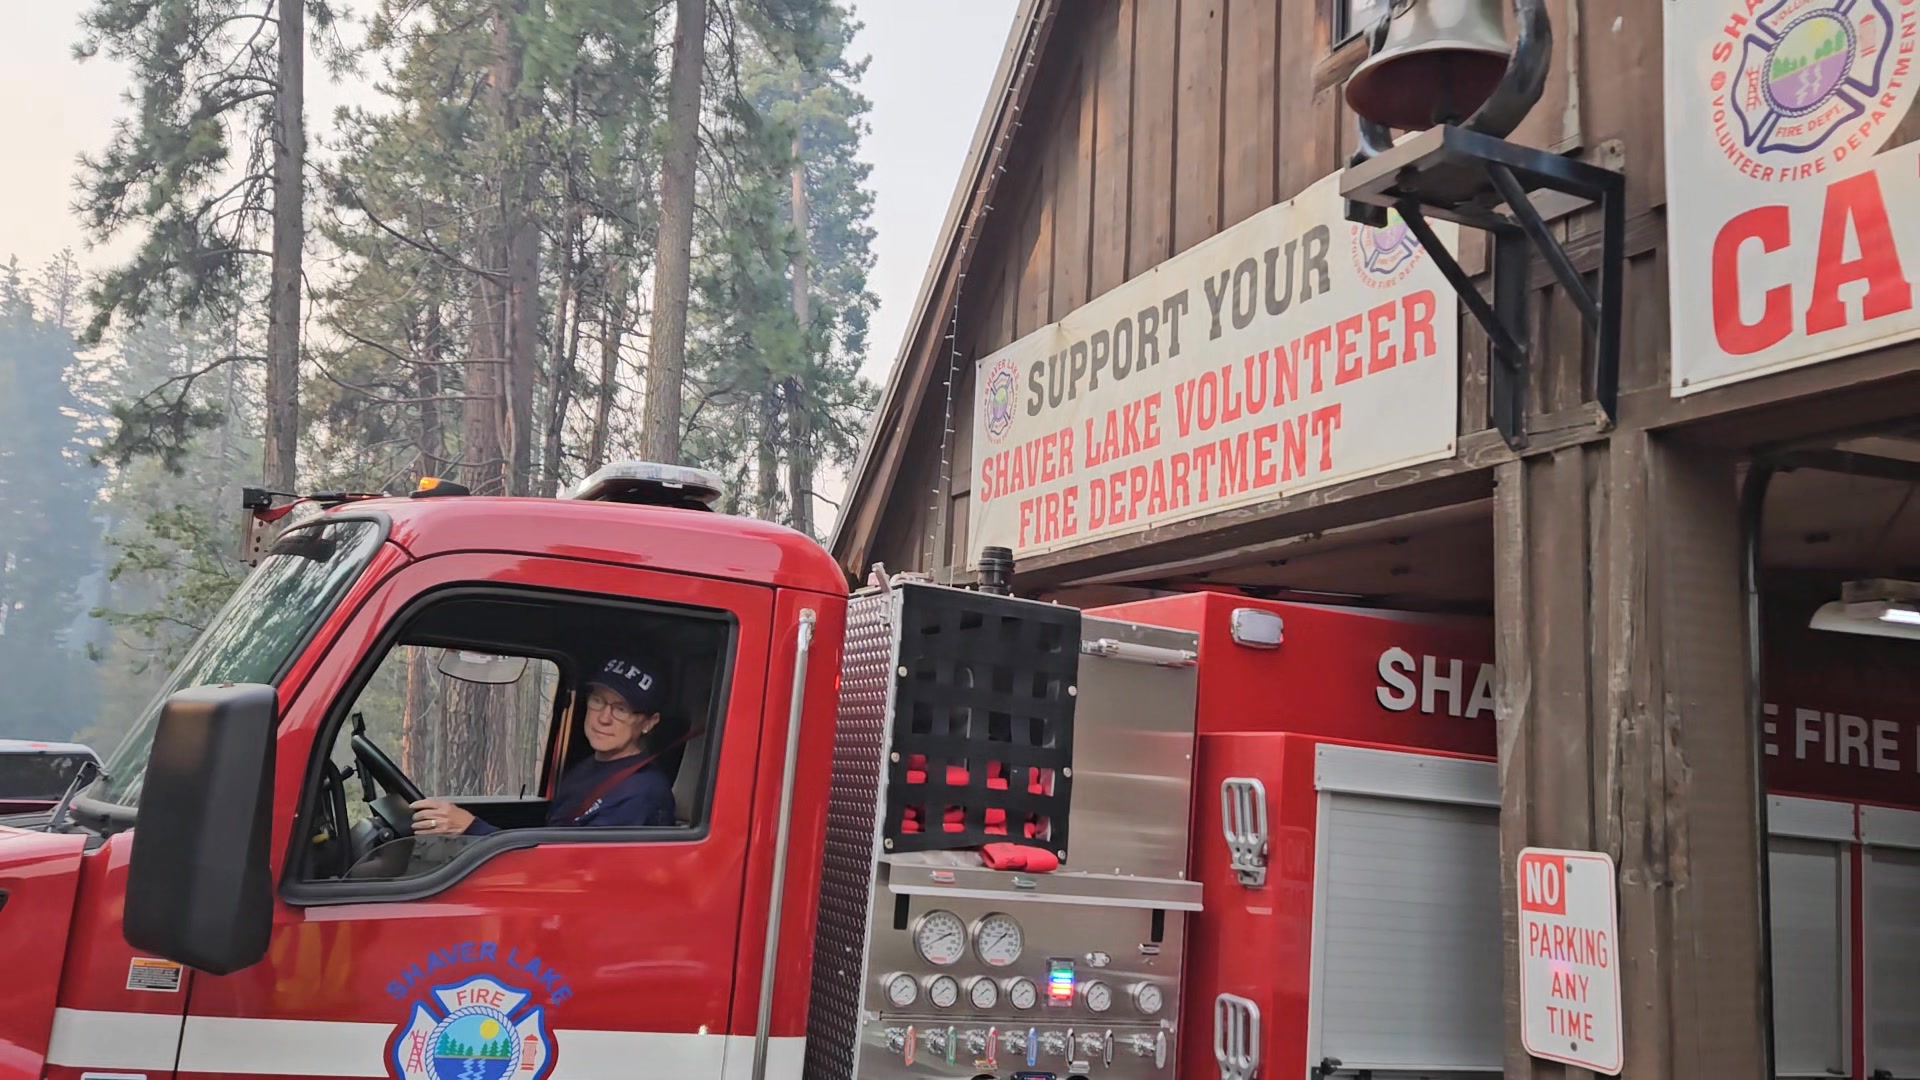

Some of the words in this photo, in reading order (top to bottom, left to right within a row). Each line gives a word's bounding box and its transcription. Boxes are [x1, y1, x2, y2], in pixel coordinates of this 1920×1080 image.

[1712, 0, 1765, 63] SHA
[1712, 94, 1774, 182] VOLUNTEER
[1779, 156, 1827, 183] FIRE
[1833, 10, 1916, 163] DEPARTMENT
[1775, 123, 1804, 138] FIRE
[1711, 151, 1920, 356] CA
[1027, 289, 1189, 417] SUPPORT
[1203, 224, 1331, 341] YOUR
[980, 427, 1075, 503] SHAVER
[1085, 393, 1162, 469] LAKE
[1174, 289, 1437, 438] VOLUNTEER
[1018, 486, 1079, 548] FIRE
[1088, 403, 1342, 532] DEPARTMENT
[604, 659, 653, 691] SLFD
[1376, 646, 1496, 719] SHA
[1795, 707, 1901, 772] FIRE
[1525, 861, 1560, 906] NO
[386, 940, 499, 1000] SHAVER
[506, 946, 574, 1006] LAKE
[1529, 921, 1608, 969] PARKING
[455, 988, 506, 1008] FIRE
[1551, 971, 1589, 1004] ANY
[1546, 1006, 1595, 1042] TIME
